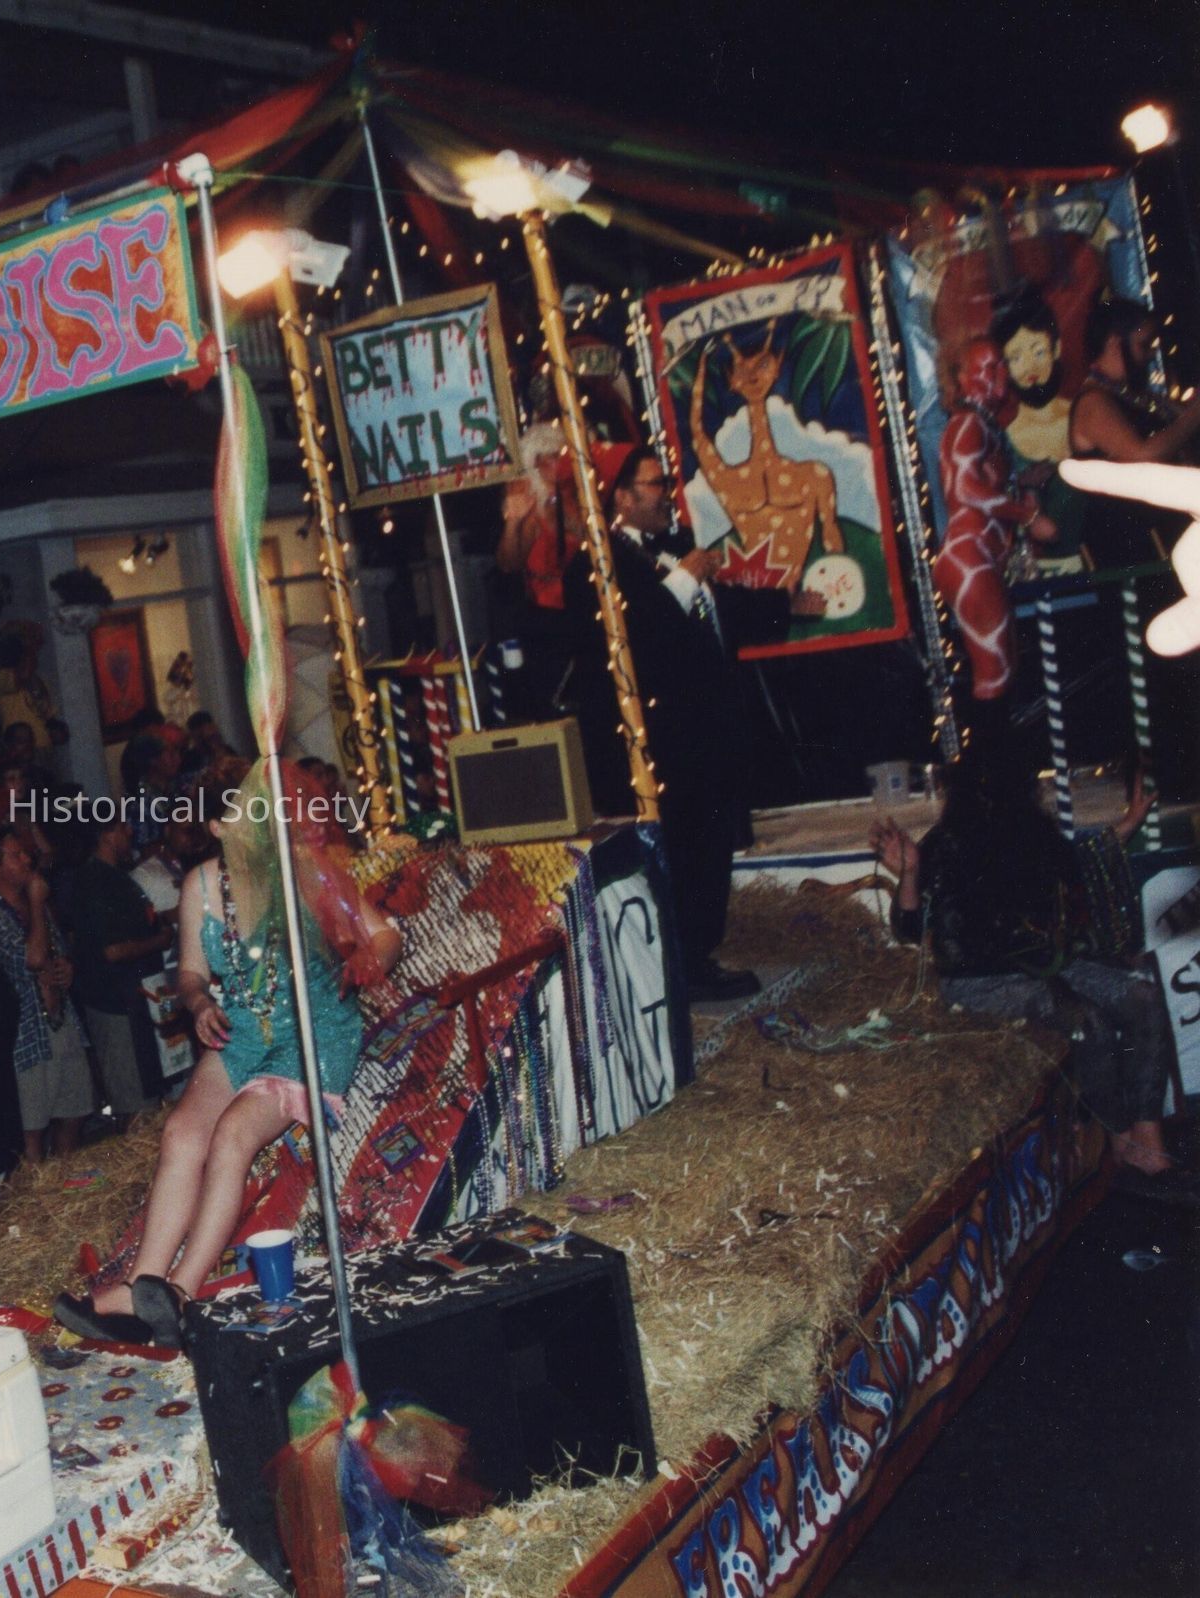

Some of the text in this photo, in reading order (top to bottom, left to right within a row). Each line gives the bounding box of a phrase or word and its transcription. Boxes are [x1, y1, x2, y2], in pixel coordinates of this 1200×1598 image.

[338, 312, 480, 394] BETTY
[679, 292, 751, 340] MAN
[349, 397, 500, 486] NAILS
